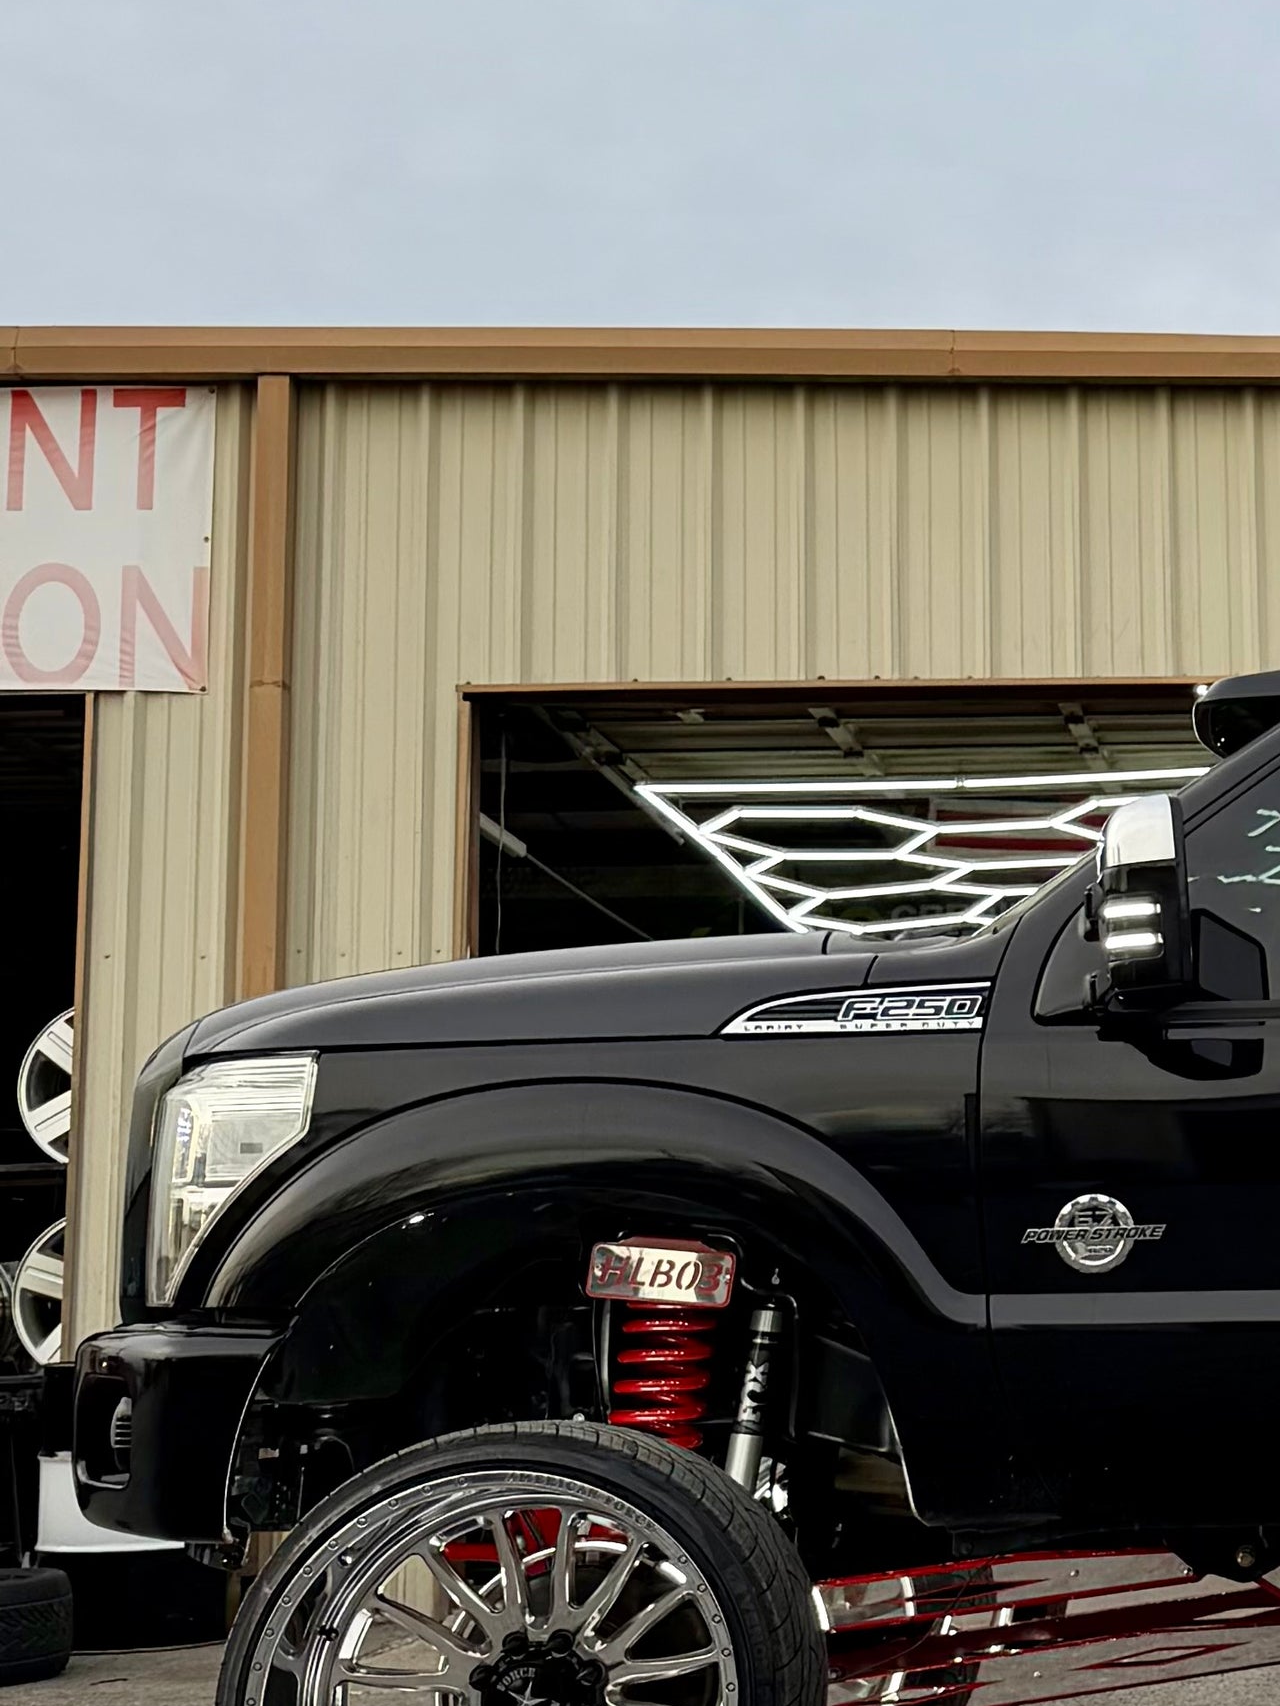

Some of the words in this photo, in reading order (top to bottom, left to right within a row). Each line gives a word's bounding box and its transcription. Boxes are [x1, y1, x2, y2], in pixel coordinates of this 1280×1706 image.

[837, 995, 983, 1021] F-250
[1022, 1228, 1090, 1243] POWER
[1089, 1224, 1167, 1241] STROKE
[505, 1472, 599, 1500] AMERICAN
[603, 1496, 657, 1533] FORCE
[496, 1667, 536, 1692] FORCE
